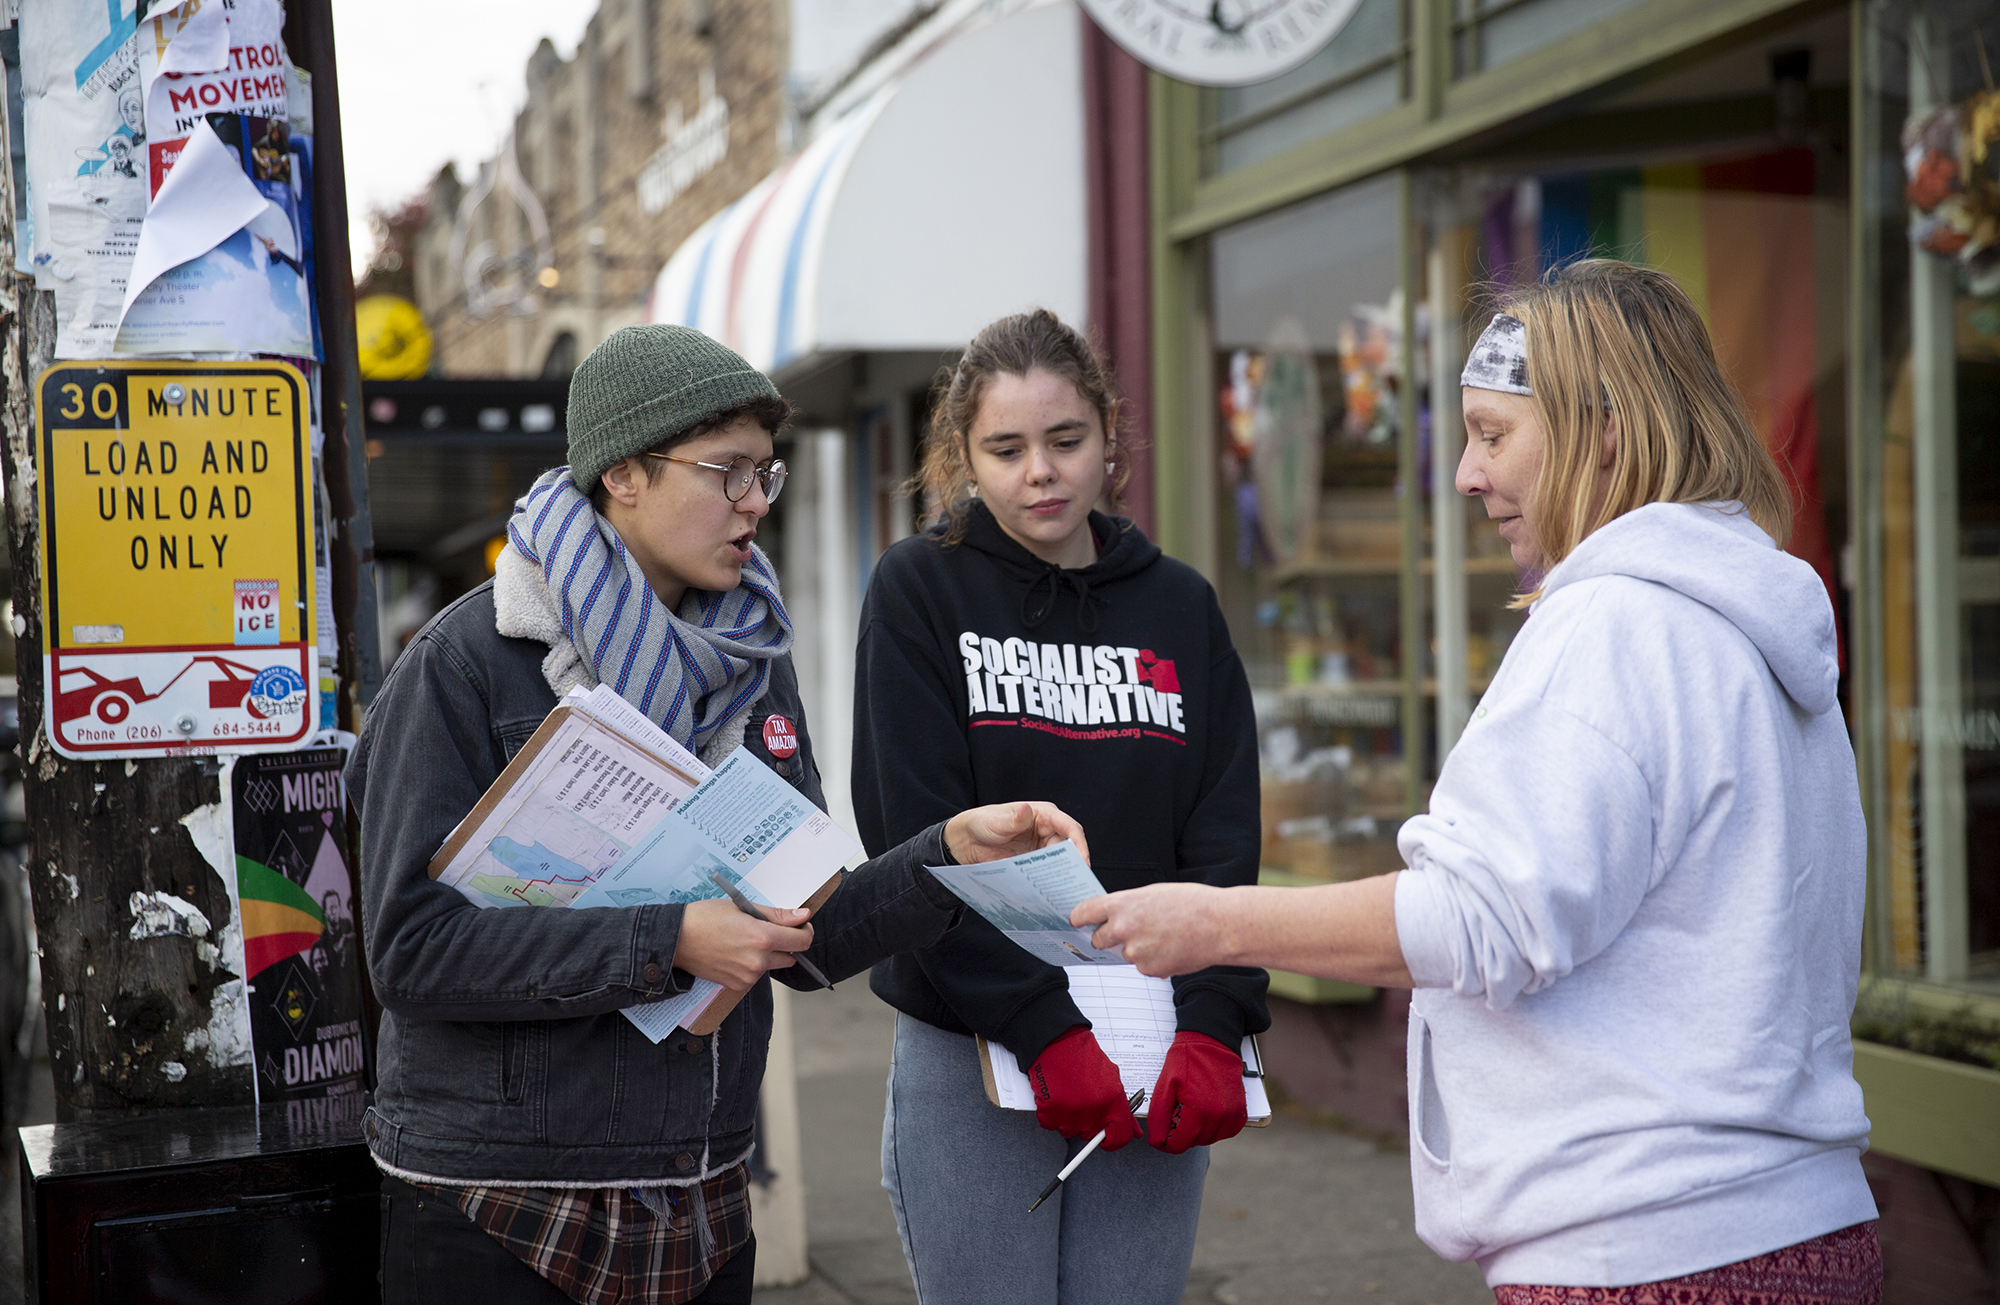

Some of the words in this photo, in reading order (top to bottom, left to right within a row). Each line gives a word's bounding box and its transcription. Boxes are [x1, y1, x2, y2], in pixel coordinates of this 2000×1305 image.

[59, 382, 119, 420] 30
[83, 440, 178, 476] LOAD
[200, 439, 270, 475] AND
[98, 484, 253, 522] UNLOAD
[130, 533, 229, 571] ONLY
[241, 593, 271, 611] NO
[238, 613, 275, 633] ICE
[958, 631, 1141, 685] SOCIALIST
[965, 671, 1187, 734] ALTERNATIVE
[77, 728, 116, 741] Phone
[126, 725, 162, 740] (206)
[212, 721, 282, 736] 684-5444
[767, 734, 797, 751] AMAZON
[770, 719, 788, 735] TAX
[1020, 717, 1142, 741] SocialistAlternative.org
[676, 793, 699, 815] Making
[697, 776, 717, 796] things
[714, 755, 739, 779] happen
